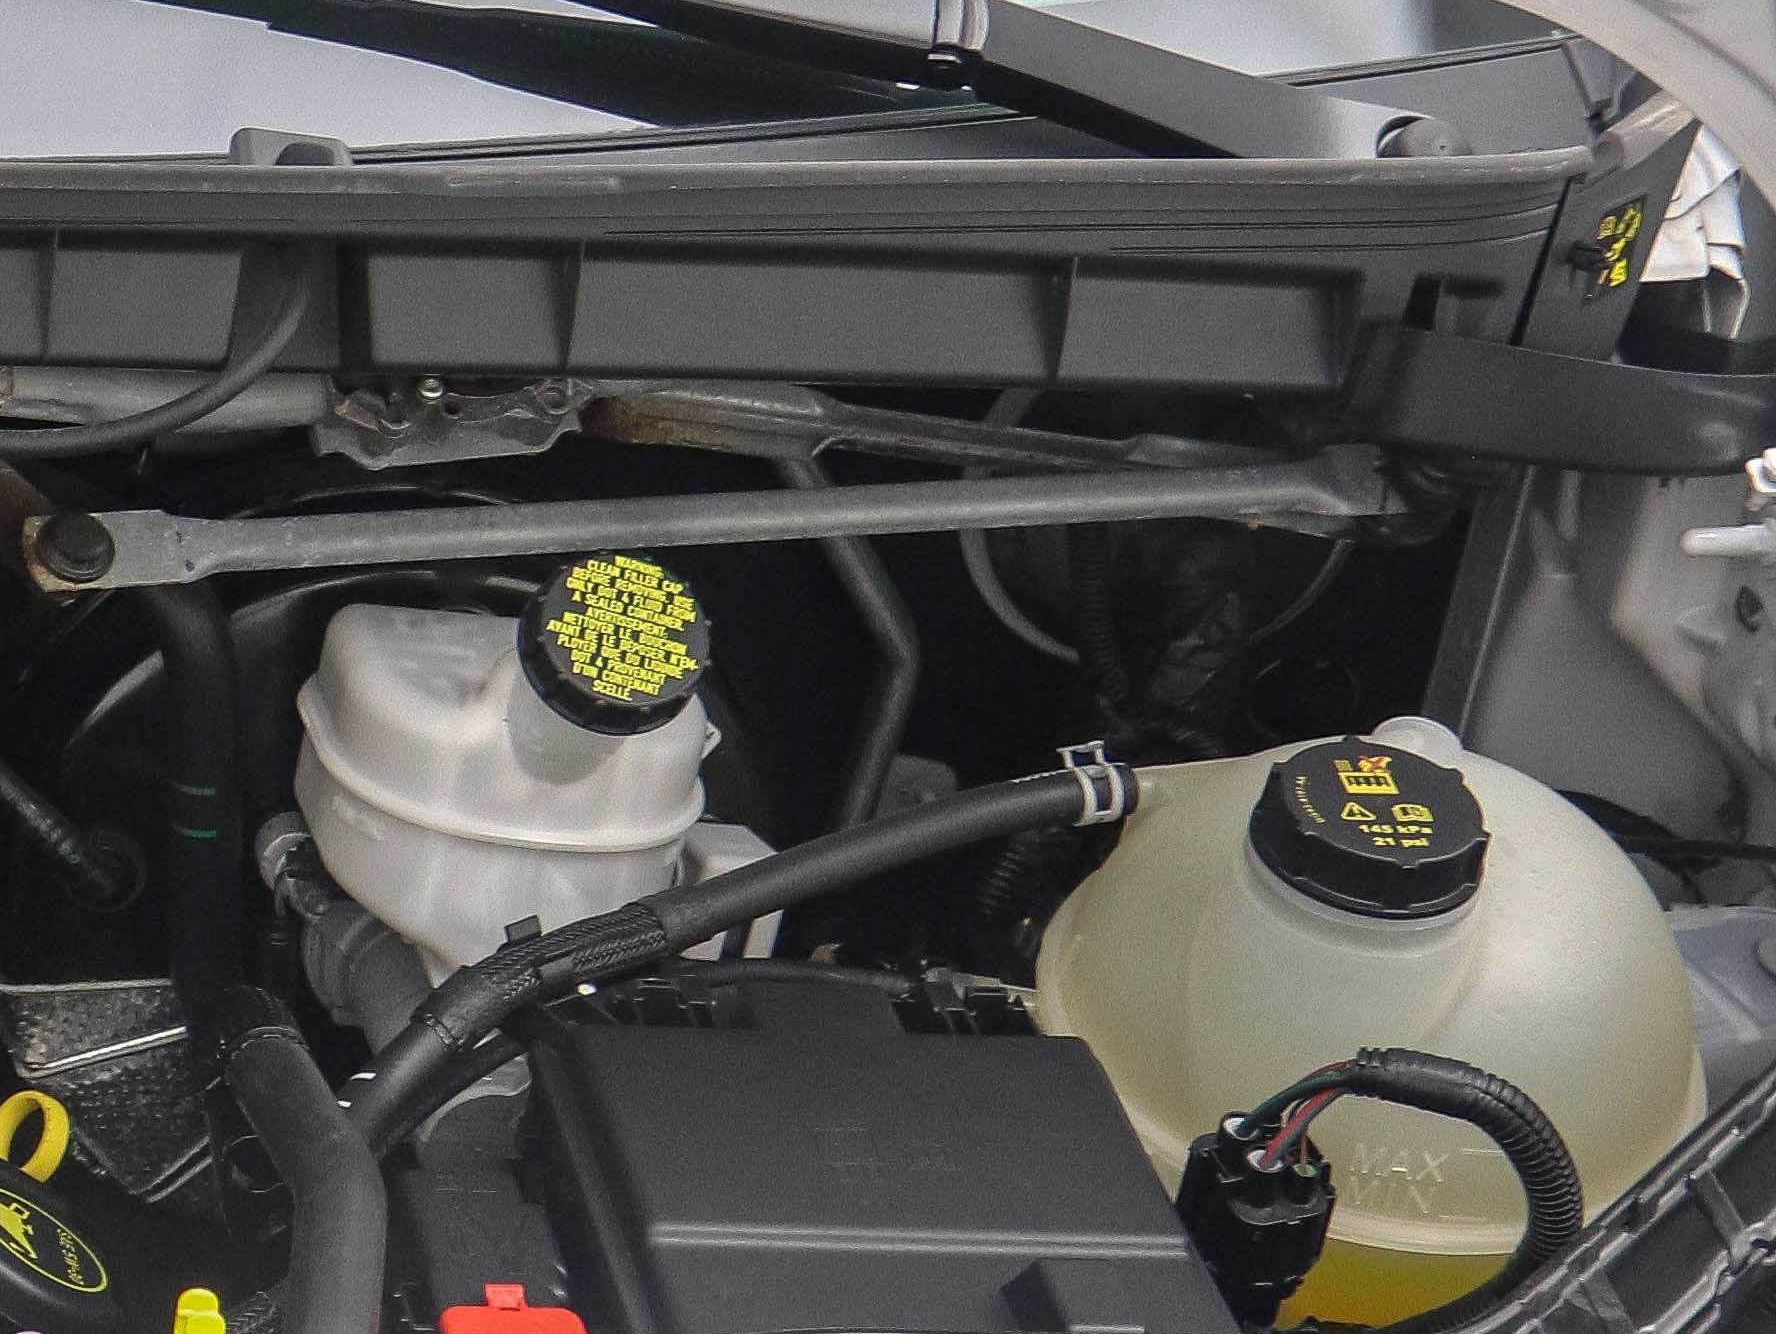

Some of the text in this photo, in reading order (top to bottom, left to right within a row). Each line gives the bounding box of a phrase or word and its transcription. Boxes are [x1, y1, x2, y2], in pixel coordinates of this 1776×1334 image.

[572, 567, 611, 587] BEFORE
[673, 595, 695, 610] USE
[587, 559, 684, 595] CLEAN FILLER CAP
[566, 577, 697, 623] ONLY DOT 4 FLUID FROM
[571, 590, 581, 602] A
[584, 594, 625, 613] SEALED
[546, 619, 581, 637] AVANT
[584, 629, 598, 642] DE
[602, 635, 616, 648] LE
[563, 611, 616, 635] NETTOYER
[639, 633, 688, 655] BOUCHON
[557, 633, 683, 680] PLOYER QUE DU LIQUIDE
[570, 649, 592, 664] DOT
[595, 656, 603, 668] 4
[602, 670, 661, 696] CONTENANT
[1359, 824, 1433, 834] 145 kPa
[1372, 836, 1429, 848] 21 psi
[1348, 1143, 1448, 1183] MAX
